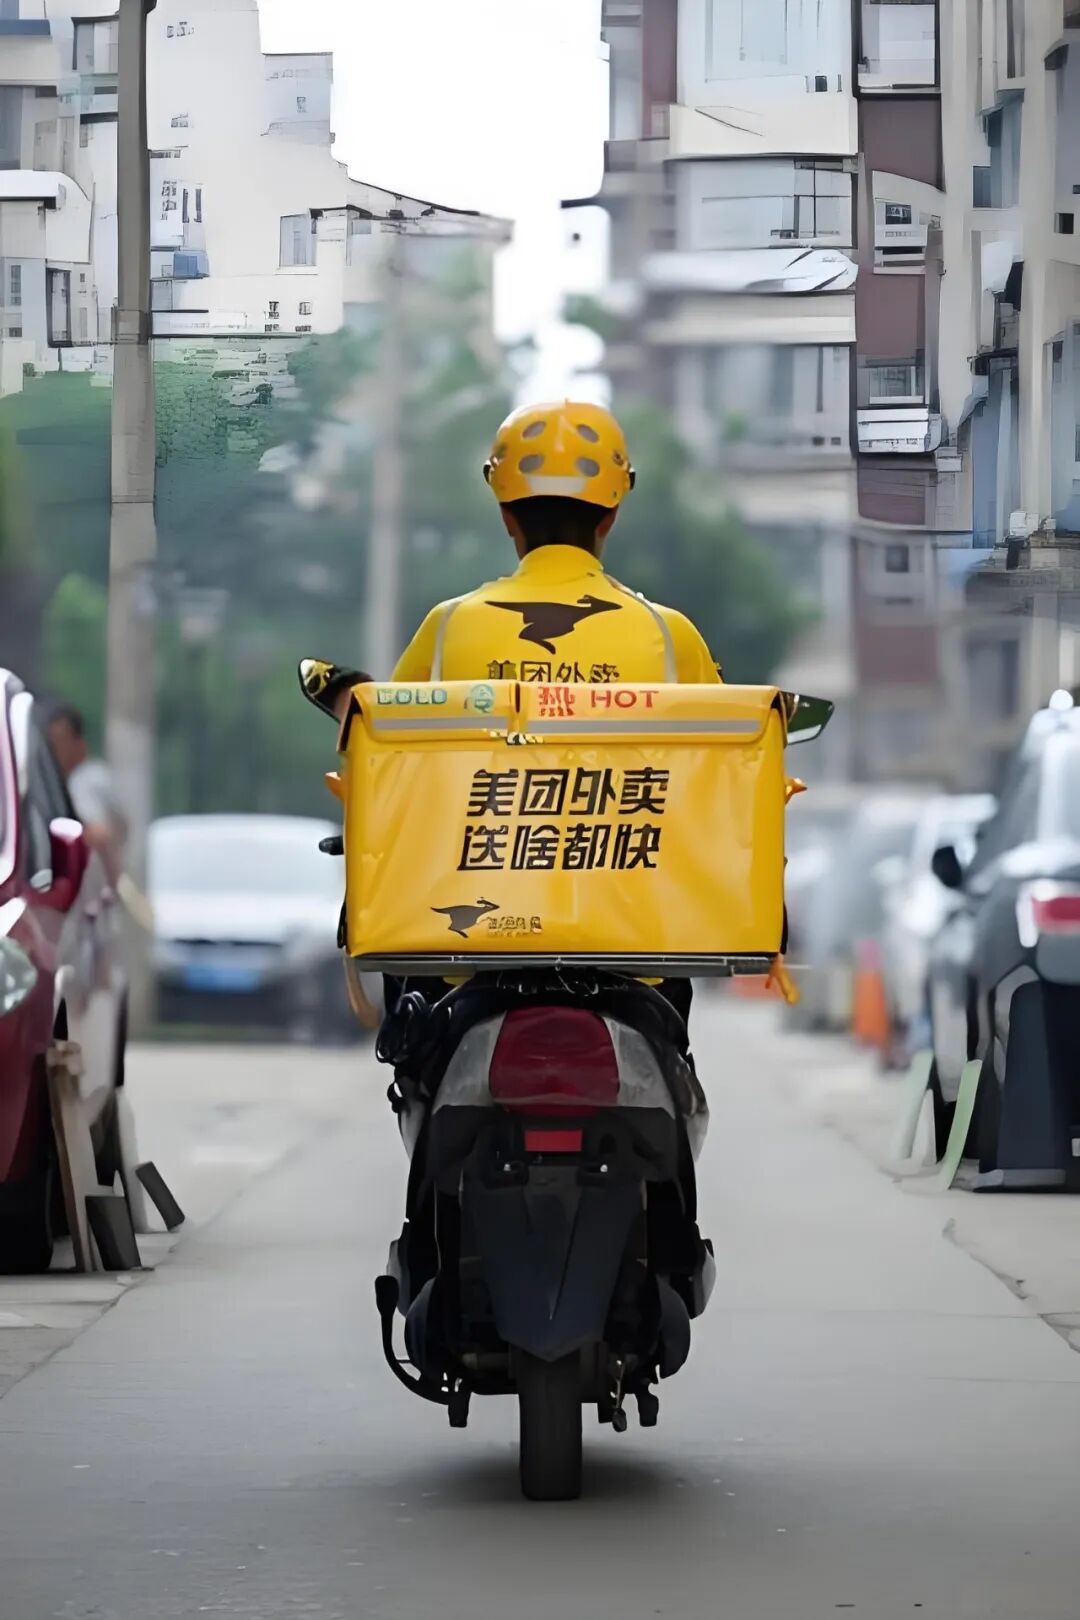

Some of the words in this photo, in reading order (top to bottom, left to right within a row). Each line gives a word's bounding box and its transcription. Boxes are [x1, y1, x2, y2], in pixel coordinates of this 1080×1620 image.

[590, 690, 660, 709] HOT
[466, 766, 670, 817] 美团外卖
[456, 822, 662, 871] 送啥都快
